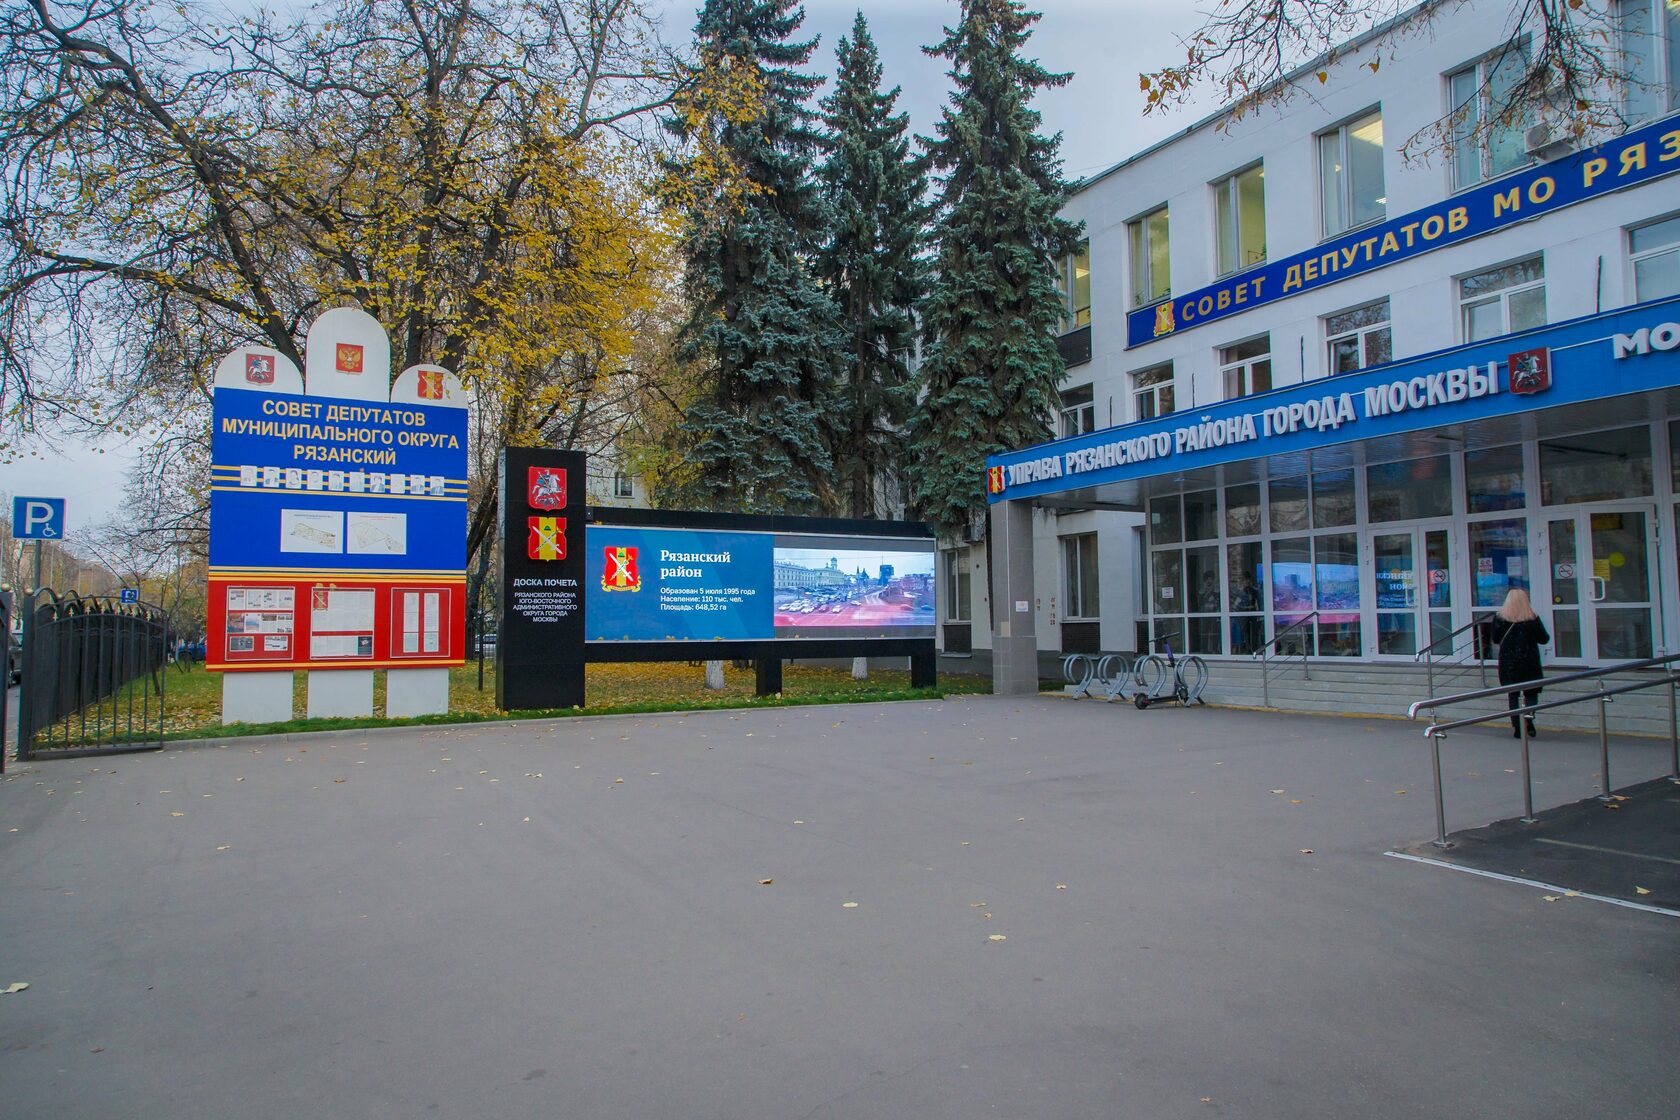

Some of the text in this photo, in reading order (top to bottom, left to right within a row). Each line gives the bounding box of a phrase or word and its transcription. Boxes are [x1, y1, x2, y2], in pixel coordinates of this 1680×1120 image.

[1181, 129, 1680, 322] СОВЕТ ДЕПУТАТОВ МО РЯЗ
[1613, 322, 1680, 360] МО
[262, 399, 426, 427] СОВЕТ ДЕПУТАТОВ
[1008, 361, 1499, 486] УПРАВА РЯЗАНСКОГО РАЙОНА ГОРОДА МОСКВЫ
[222, 418, 459, 449] МУНИЦИПАЛЬНОГО ОКРУГА
[293, 444, 396, 465] РЯЗАНСКИЙ
[25, 501, 54, 534] P
[660, 549, 731, 563] Рязанский
[513, 578, 578, 587] ДОСКА ПОЧЕТА
[660, 565, 703, 580] район
[660, 587, 699, 595] Образован
[740, 588, 756, 596] года
[660, 595, 701, 603] Население:
[660, 603, 694, 611] Площадь:
[695, 603, 719, 611] 648,52
